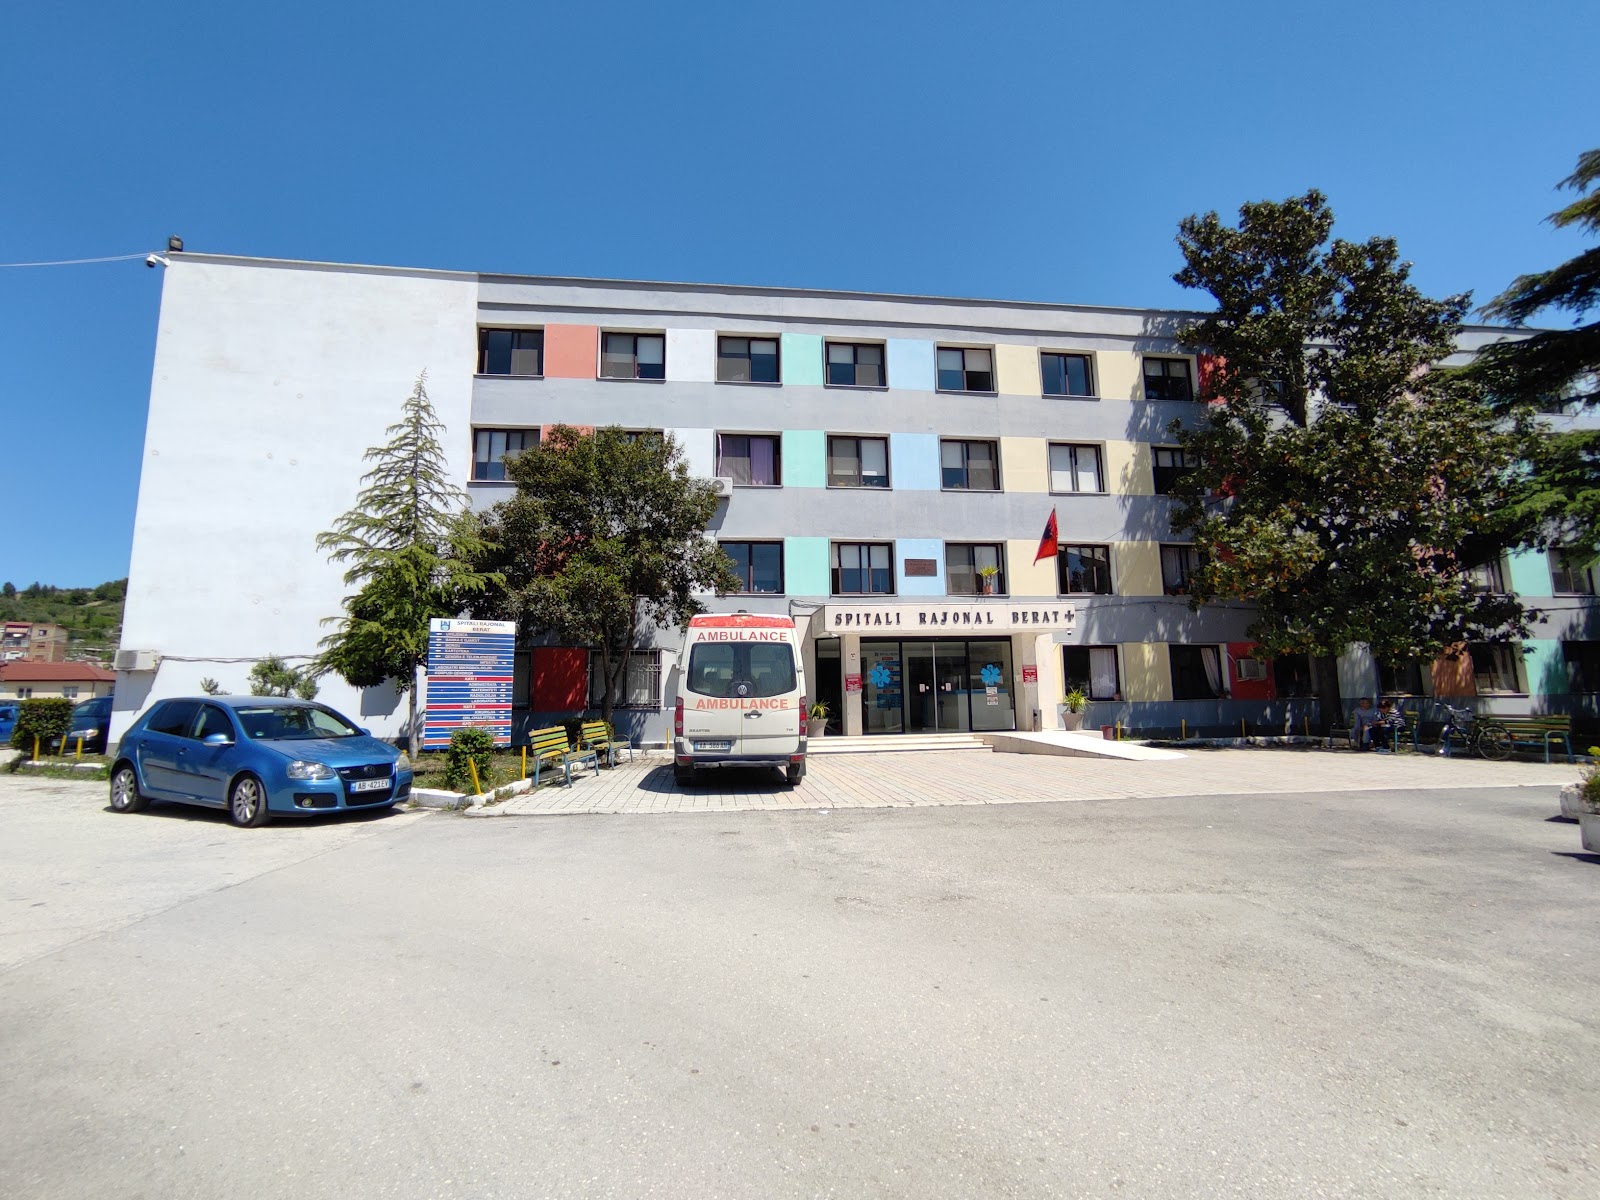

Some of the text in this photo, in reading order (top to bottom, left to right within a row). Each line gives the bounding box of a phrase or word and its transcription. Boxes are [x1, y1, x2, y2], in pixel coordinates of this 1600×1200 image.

[834, 610, 1060, 626] SPITALI RAJONAL BERAT
[696, 631, 788, 642] AMBULANCE
[696, 698, 789, 710] AMBULANCE
